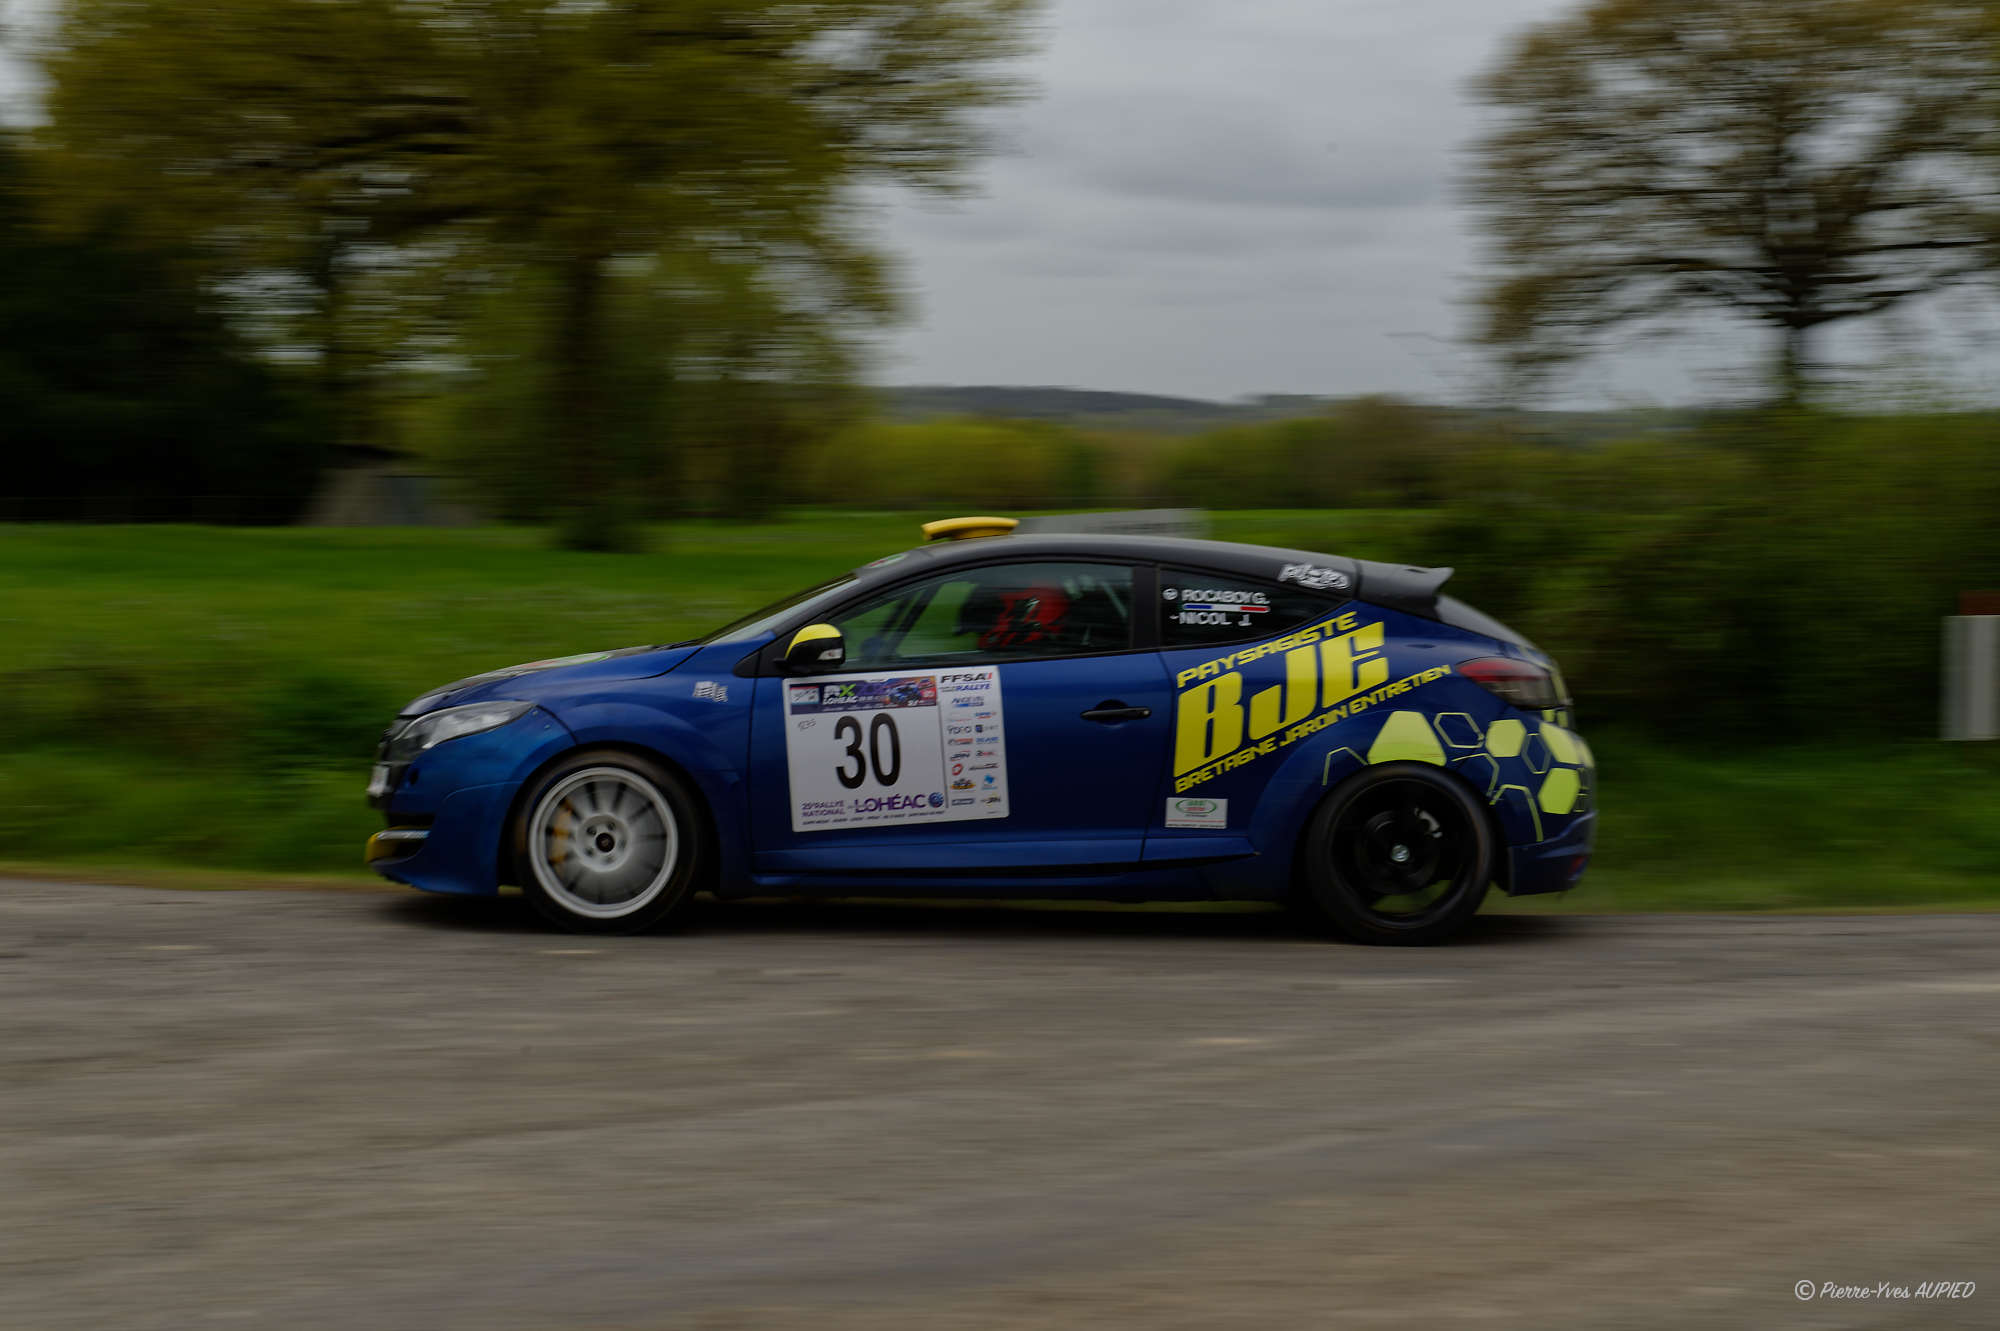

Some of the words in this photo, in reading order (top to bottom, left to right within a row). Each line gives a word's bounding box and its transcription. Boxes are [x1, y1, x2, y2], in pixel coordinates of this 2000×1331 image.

[1179, 612, 1232, 625] NICOL
[1177, 611, 1358, 688] PAYSAGISTE
[941, 673, 987, 683] FFSA
[834, 713, 901, 789] 30
[1175, 737, 1277, 794] BRETAGNE
[1280, 705, 1349, 746] JARDIN
[1349, 664, 1452, 714] ENTRETIEN
[854, 794, 926, 813] LOHÉAC
